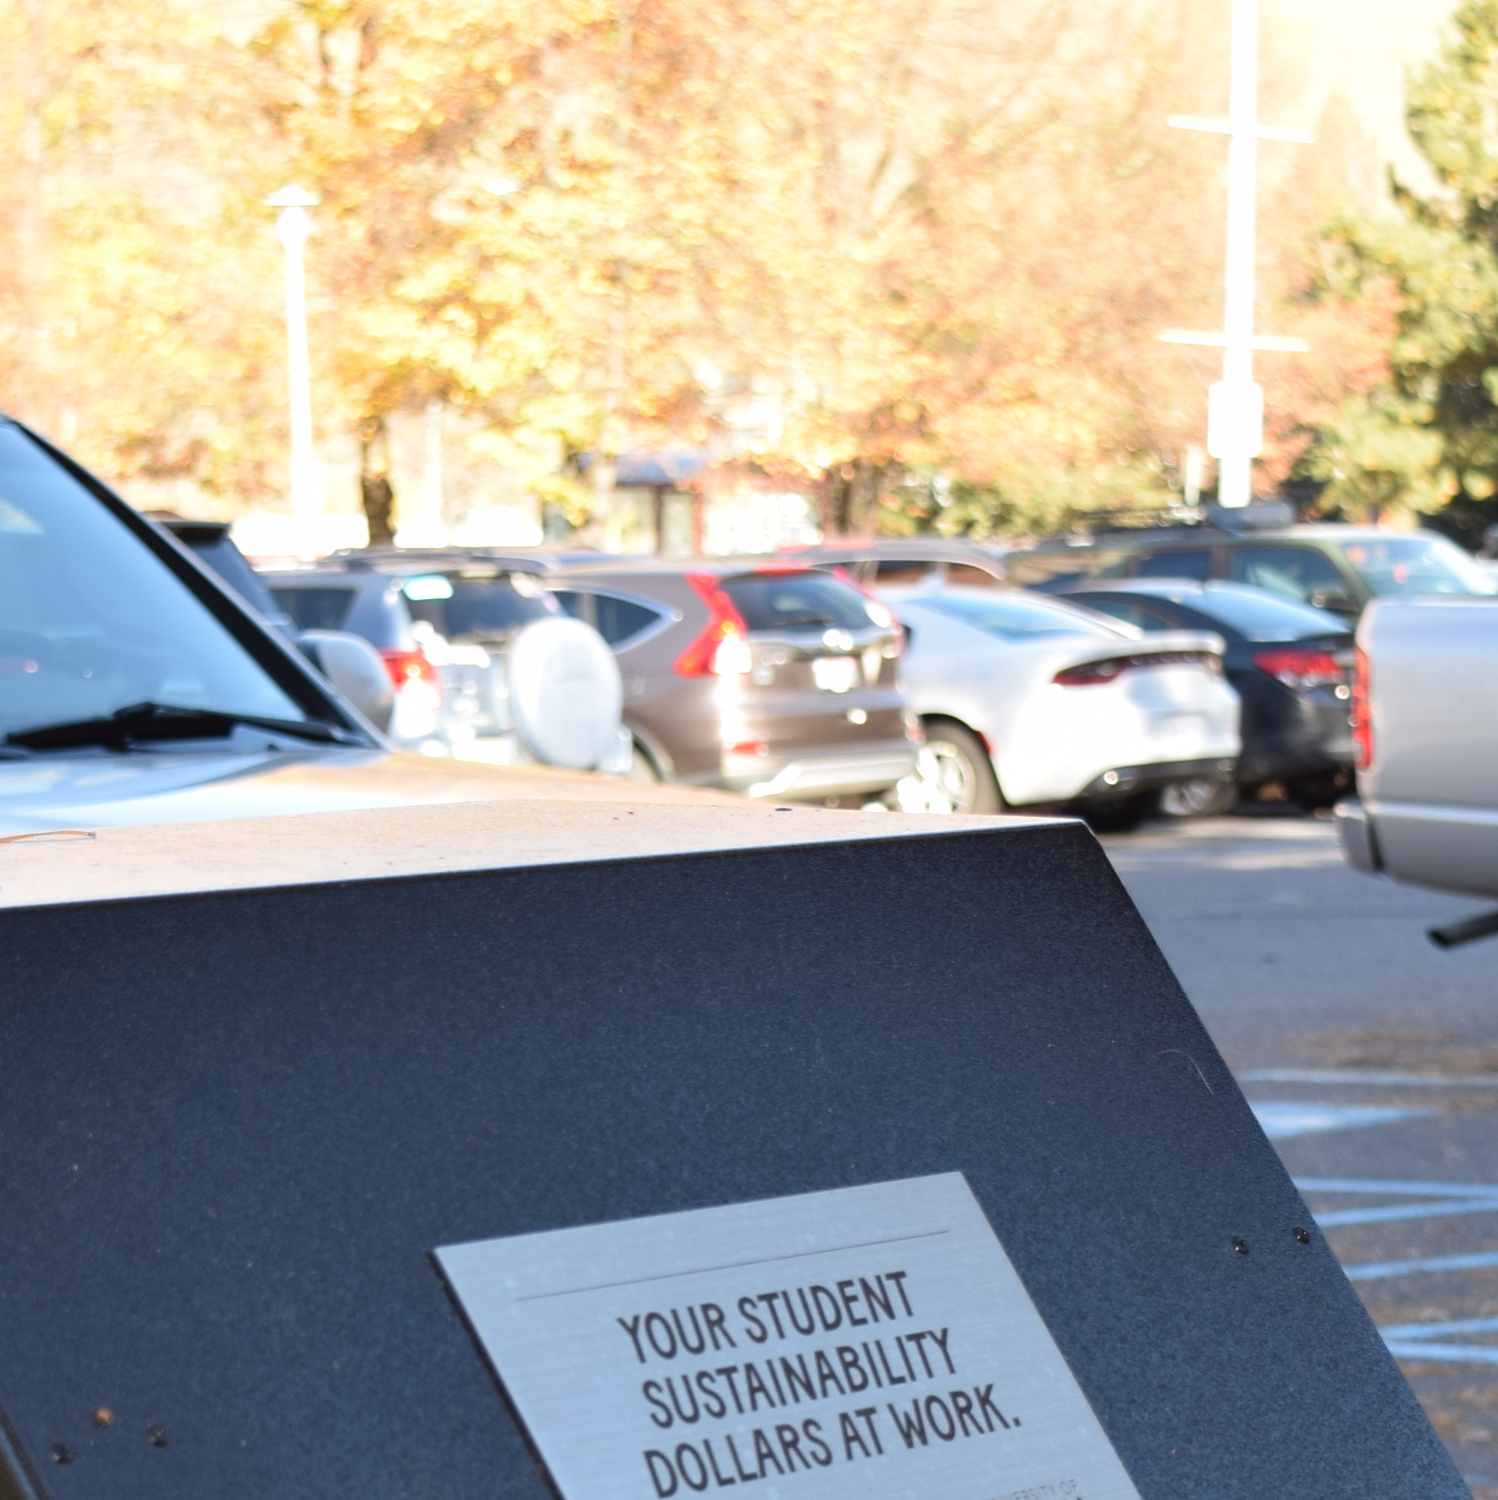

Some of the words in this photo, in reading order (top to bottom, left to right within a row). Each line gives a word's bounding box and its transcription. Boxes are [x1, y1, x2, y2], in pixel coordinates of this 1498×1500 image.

[617, 1302, 737, 1364] YOUR
[737, 1270, 914, 1344] STUDENT
[642, 1327, 956, 1429] SUSTAINABILITY
[643, 1418, 833, 1498] DOLLARS
[839, 1406, 884, 1461] AT
[887, 1383, 1022, 1449] WORK.
[1059, 1479, 1077, 1495] OF
